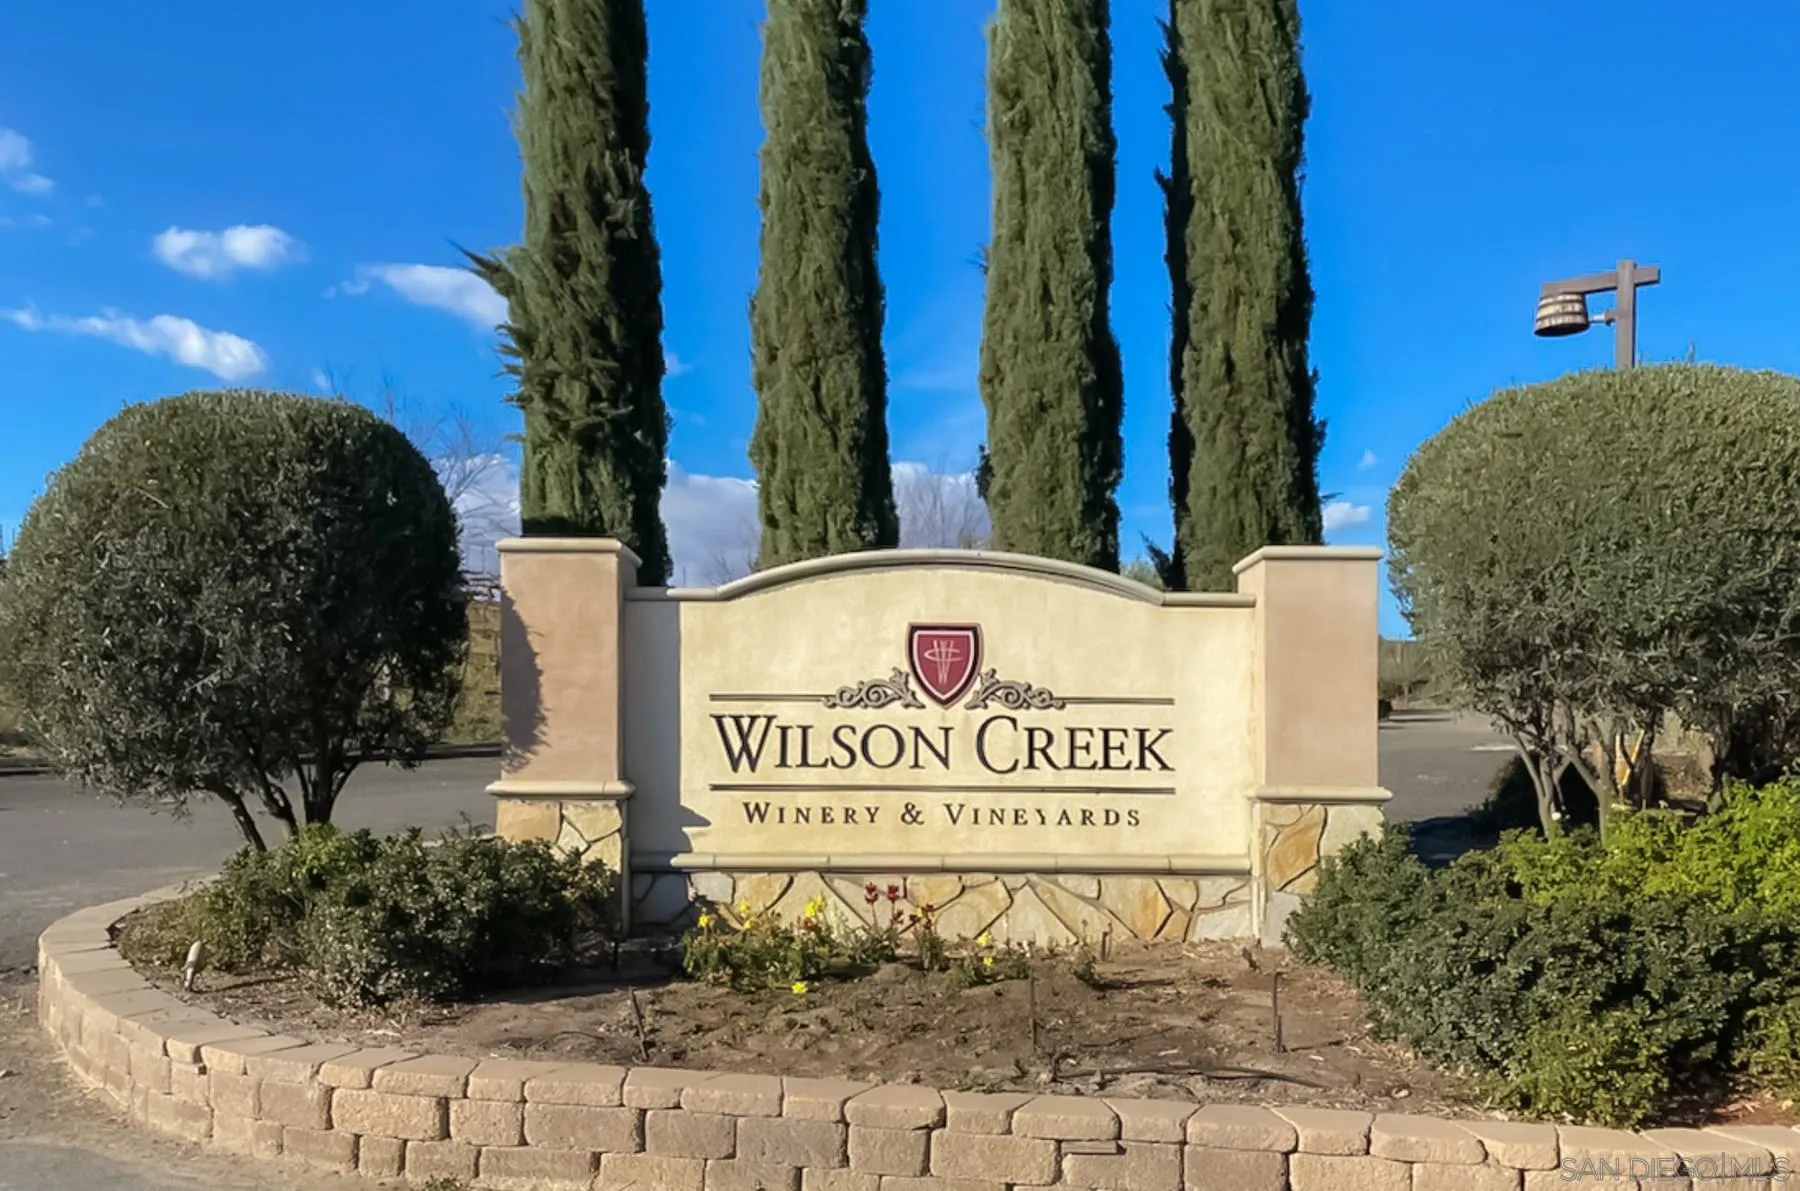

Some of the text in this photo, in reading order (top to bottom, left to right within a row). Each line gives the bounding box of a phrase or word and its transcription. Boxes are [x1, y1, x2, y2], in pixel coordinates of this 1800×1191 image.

[710, 715, 1175, 774] WILSON CREEK
[742, 802, 881, 826] WINERY
[900, 803, 925, 826] &
